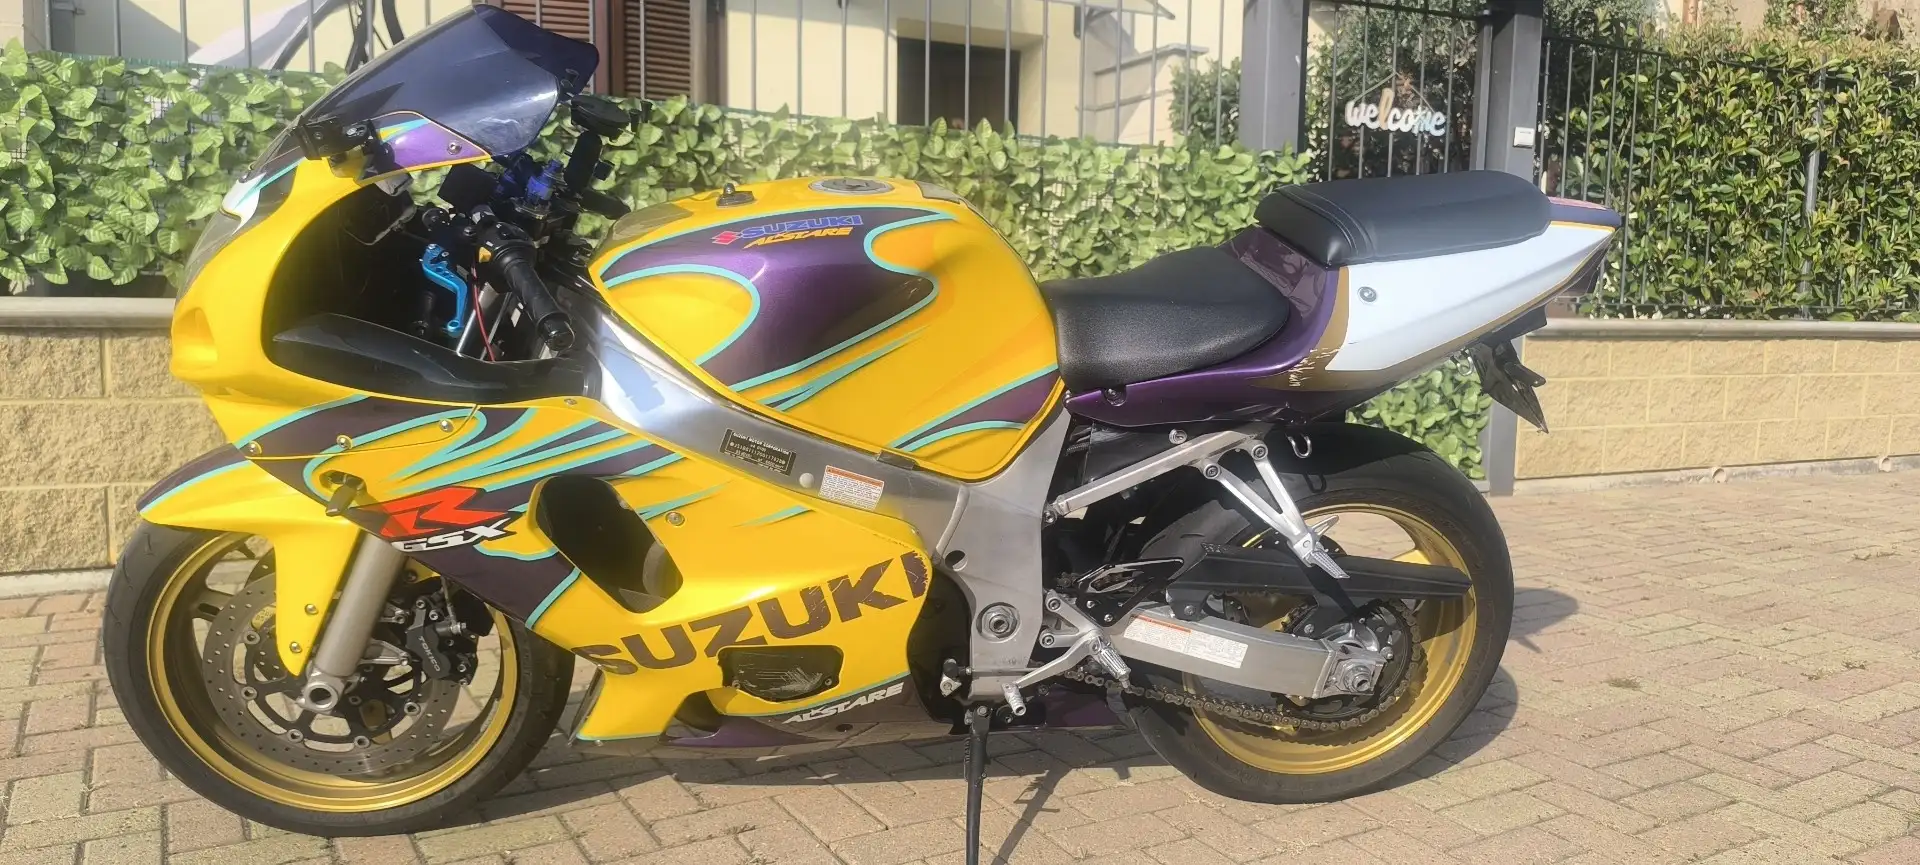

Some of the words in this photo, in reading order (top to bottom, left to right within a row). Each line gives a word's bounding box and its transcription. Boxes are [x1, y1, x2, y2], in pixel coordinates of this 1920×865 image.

[1345, 87, 1445, 137] welcome
[740, 214, 864, 239] SUZUKI
[391, 517, 512, 552] GSX
[571, 549, 930, 676] SUZUKI
[418, 635, 441, 672] TOKICO
[781, 681, 905, 725] ALSTARE
